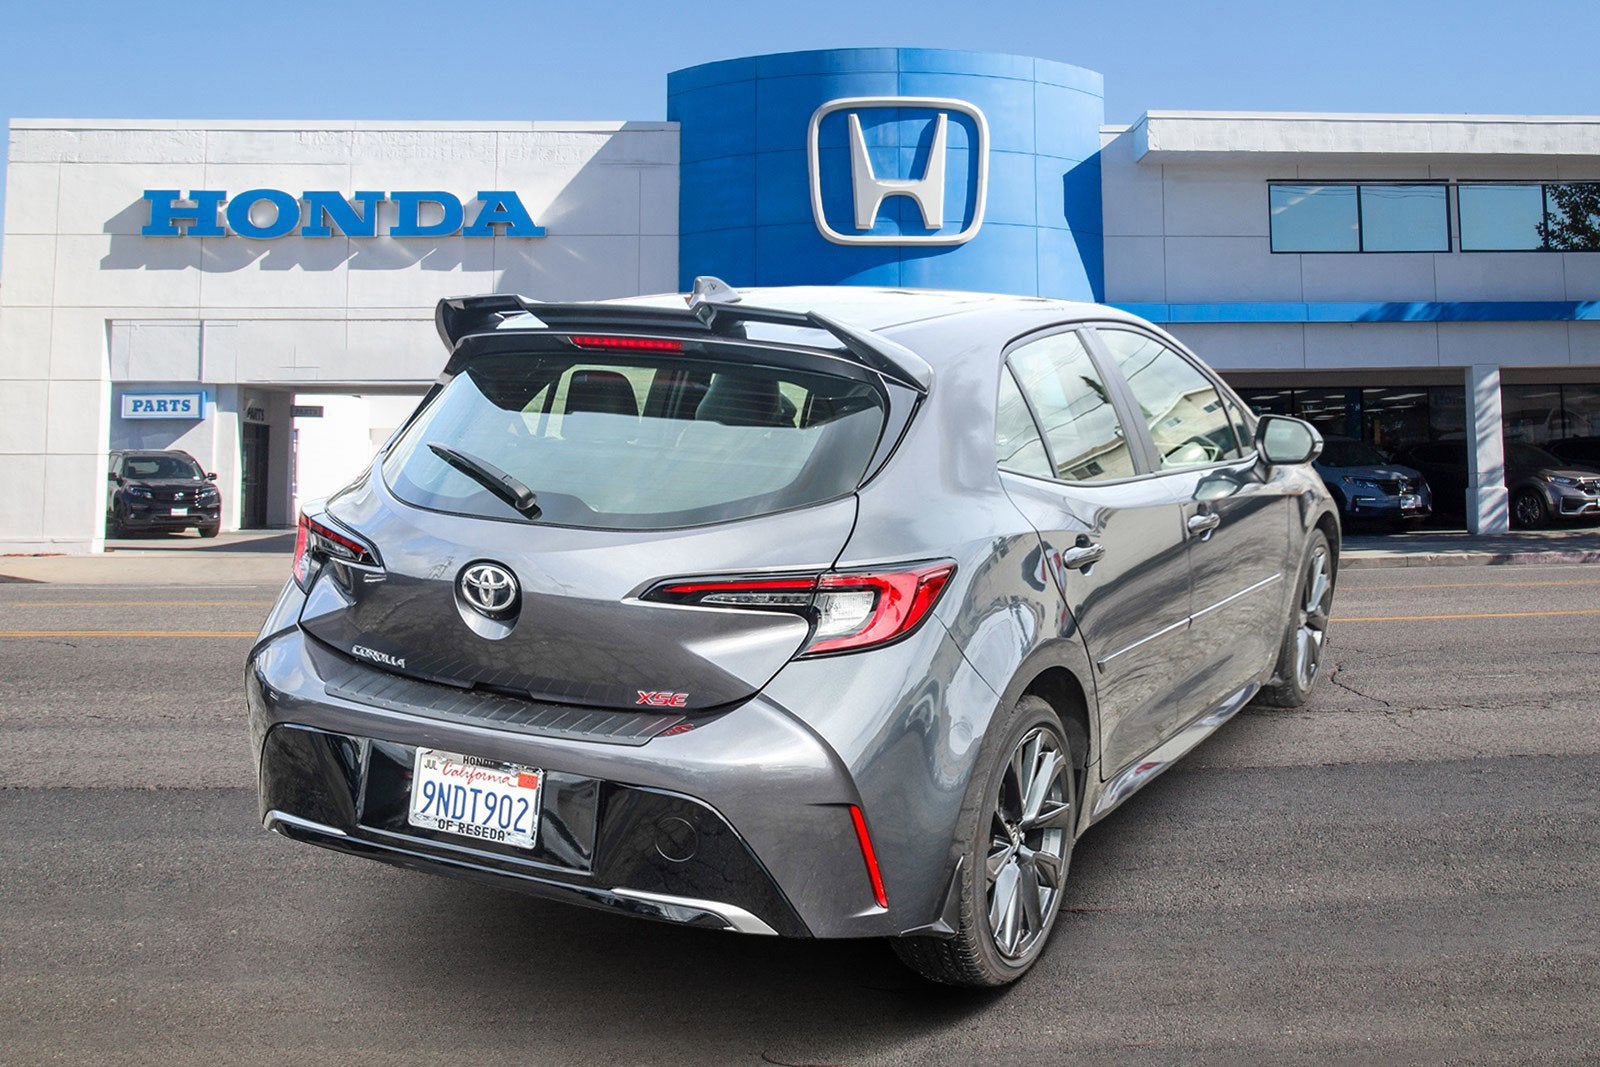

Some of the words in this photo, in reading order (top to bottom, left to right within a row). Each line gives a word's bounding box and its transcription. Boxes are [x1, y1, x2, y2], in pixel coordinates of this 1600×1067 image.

[141, 188, 547, 239] HONDA
[131, 399, 192, 413] PARTS
[635, 690, 690, 708] XSE
[442, 760, 517, 788] California
[420, 780, 529, 834] 9NDT902
[437, 819, 453, 831] OF
[457, 822, 506, 842] RESEDA
